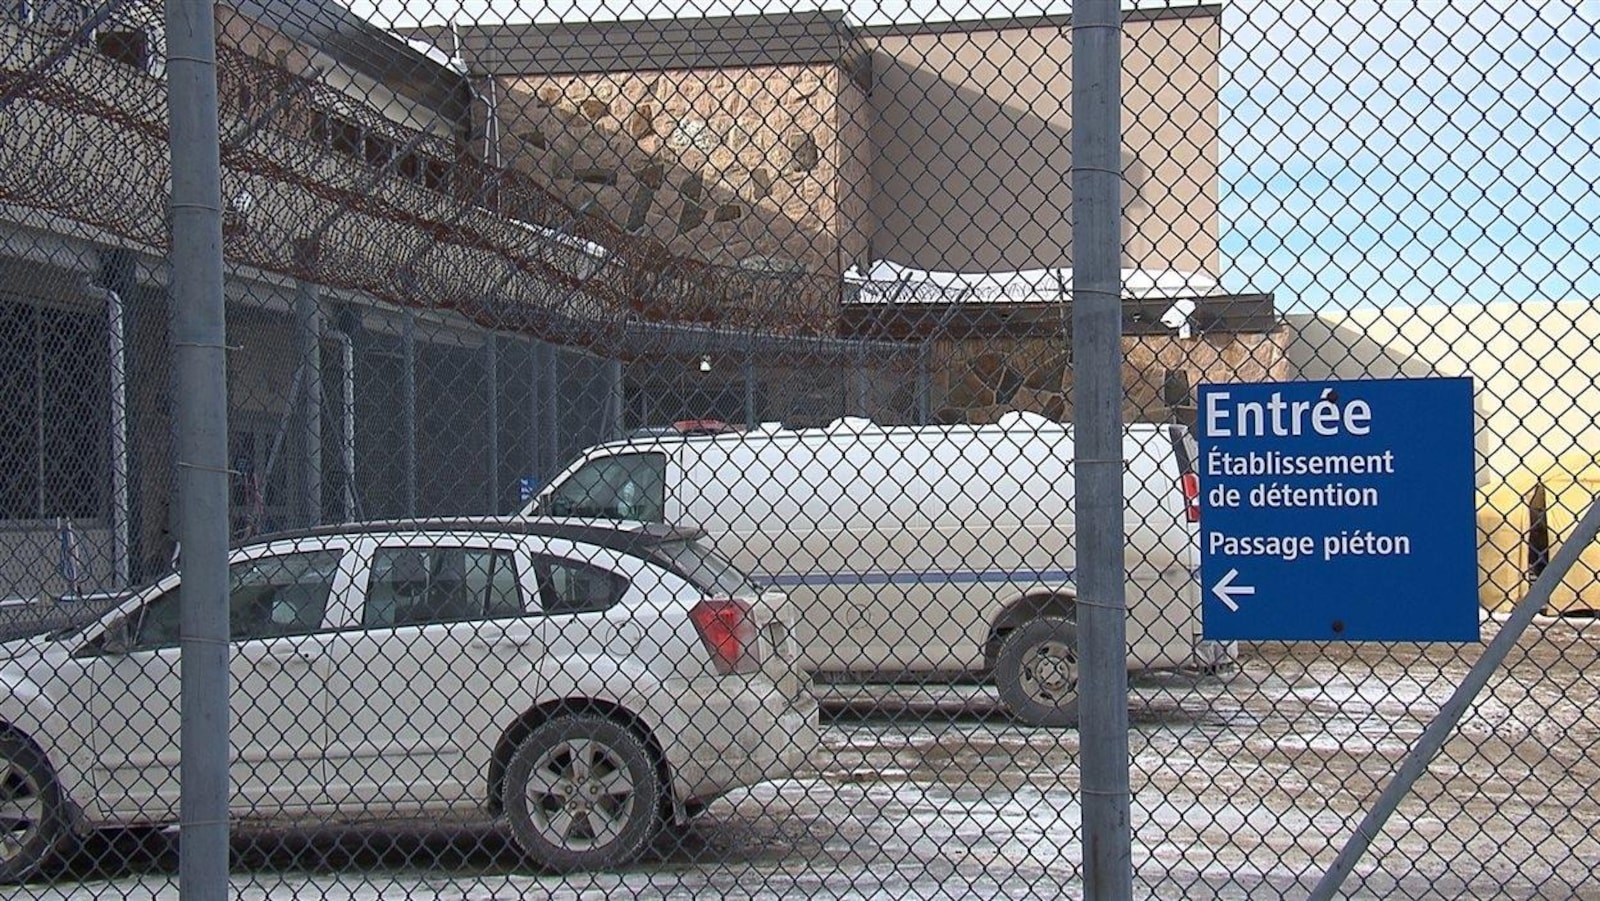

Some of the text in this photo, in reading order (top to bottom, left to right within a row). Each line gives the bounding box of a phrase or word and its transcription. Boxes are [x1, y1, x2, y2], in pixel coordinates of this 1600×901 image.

[1206, 388, 1371, 437] Entrée
[1209, 446, 1394, 475] Établissement
[1209, 483, 1377, 506] de détention
[1210, 530, 1409, 560] Passage piéton
